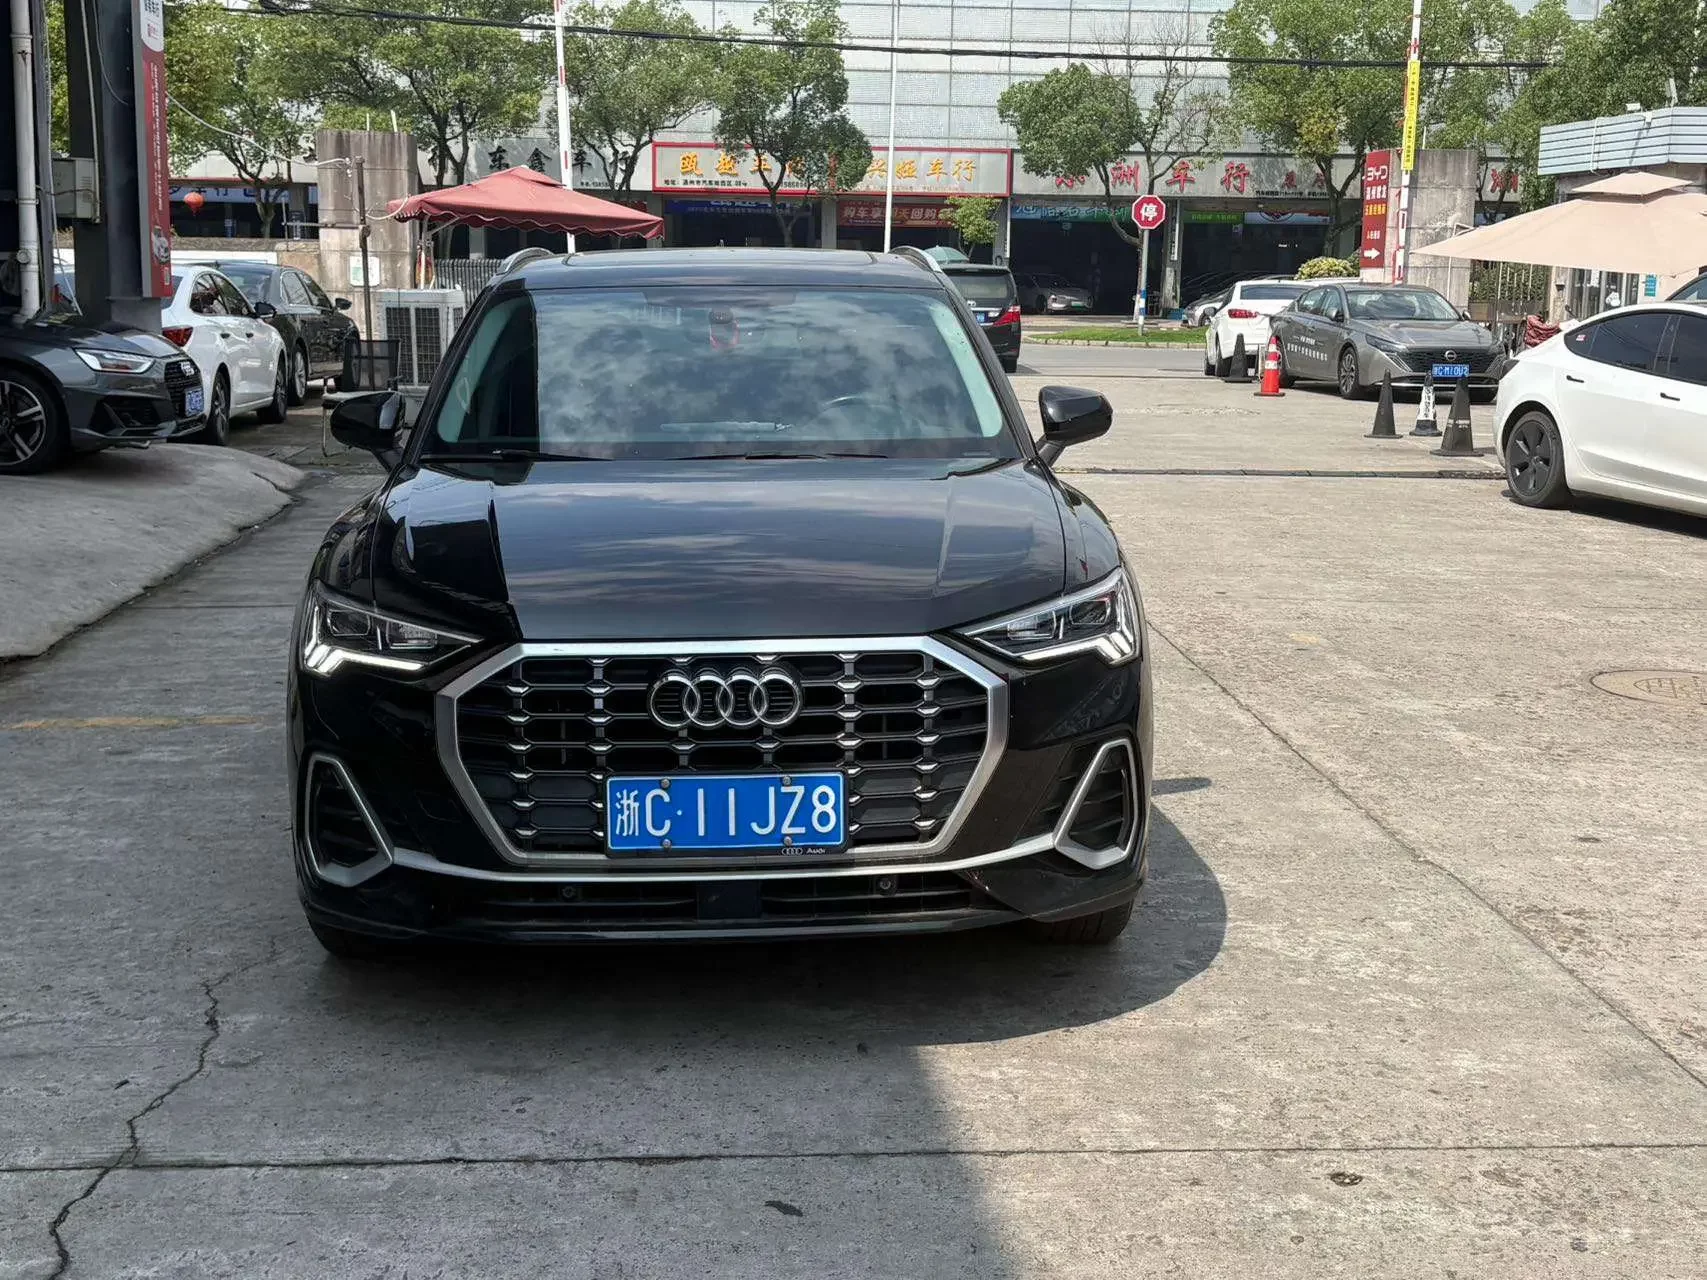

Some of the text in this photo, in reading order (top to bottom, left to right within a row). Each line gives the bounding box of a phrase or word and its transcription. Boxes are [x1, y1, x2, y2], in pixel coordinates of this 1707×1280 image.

[1367, 166, 1387, 181] BYD
[1140, 202, 1159, 223] 停
[615, 785, 837, 837] 浙C·11JZ8
